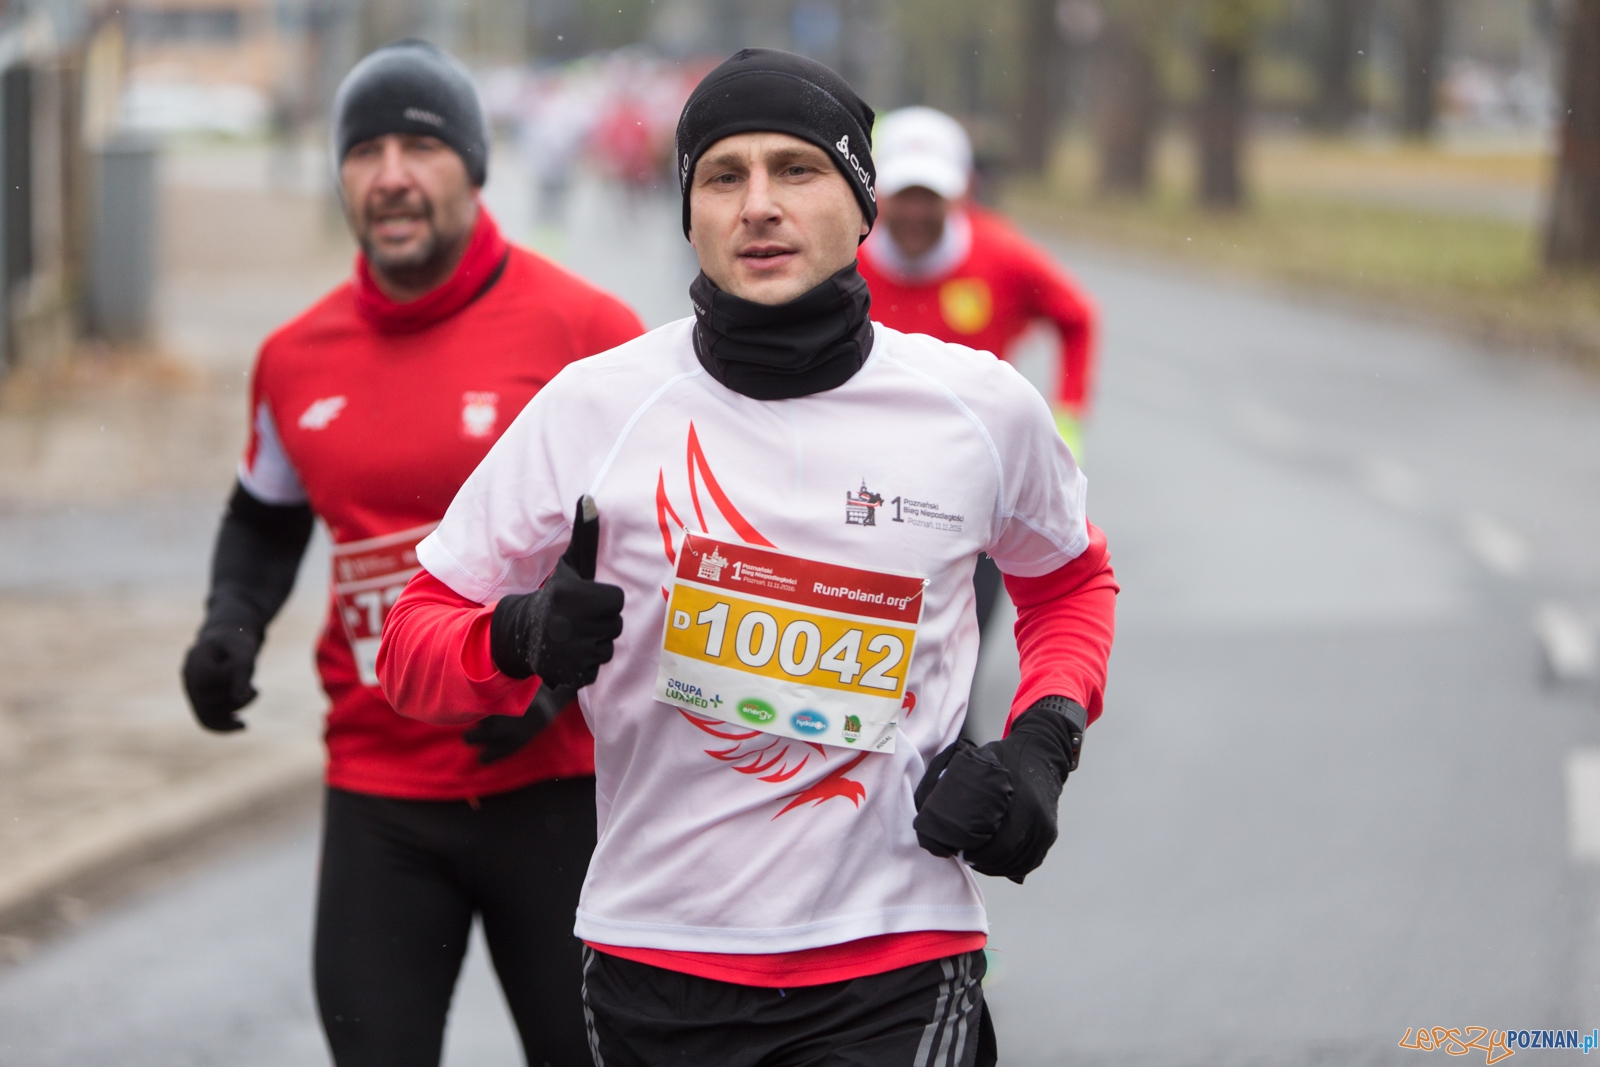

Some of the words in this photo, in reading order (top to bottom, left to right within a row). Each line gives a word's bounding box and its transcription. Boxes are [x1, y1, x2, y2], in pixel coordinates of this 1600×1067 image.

[850, 153, 876, 203] odlo
[891, 496, 904, 522] 1
[903, 498, 939, 510] Poznański
[903, 506, 919, 516] Bieg
[731, 560, 742, 581] 1
[812, 581, 908, 611] RunPoland.org
[672, 610, 691, 630] D
[696, 602, 904, 691] 10042
[743, 706, 773, 721] energy
